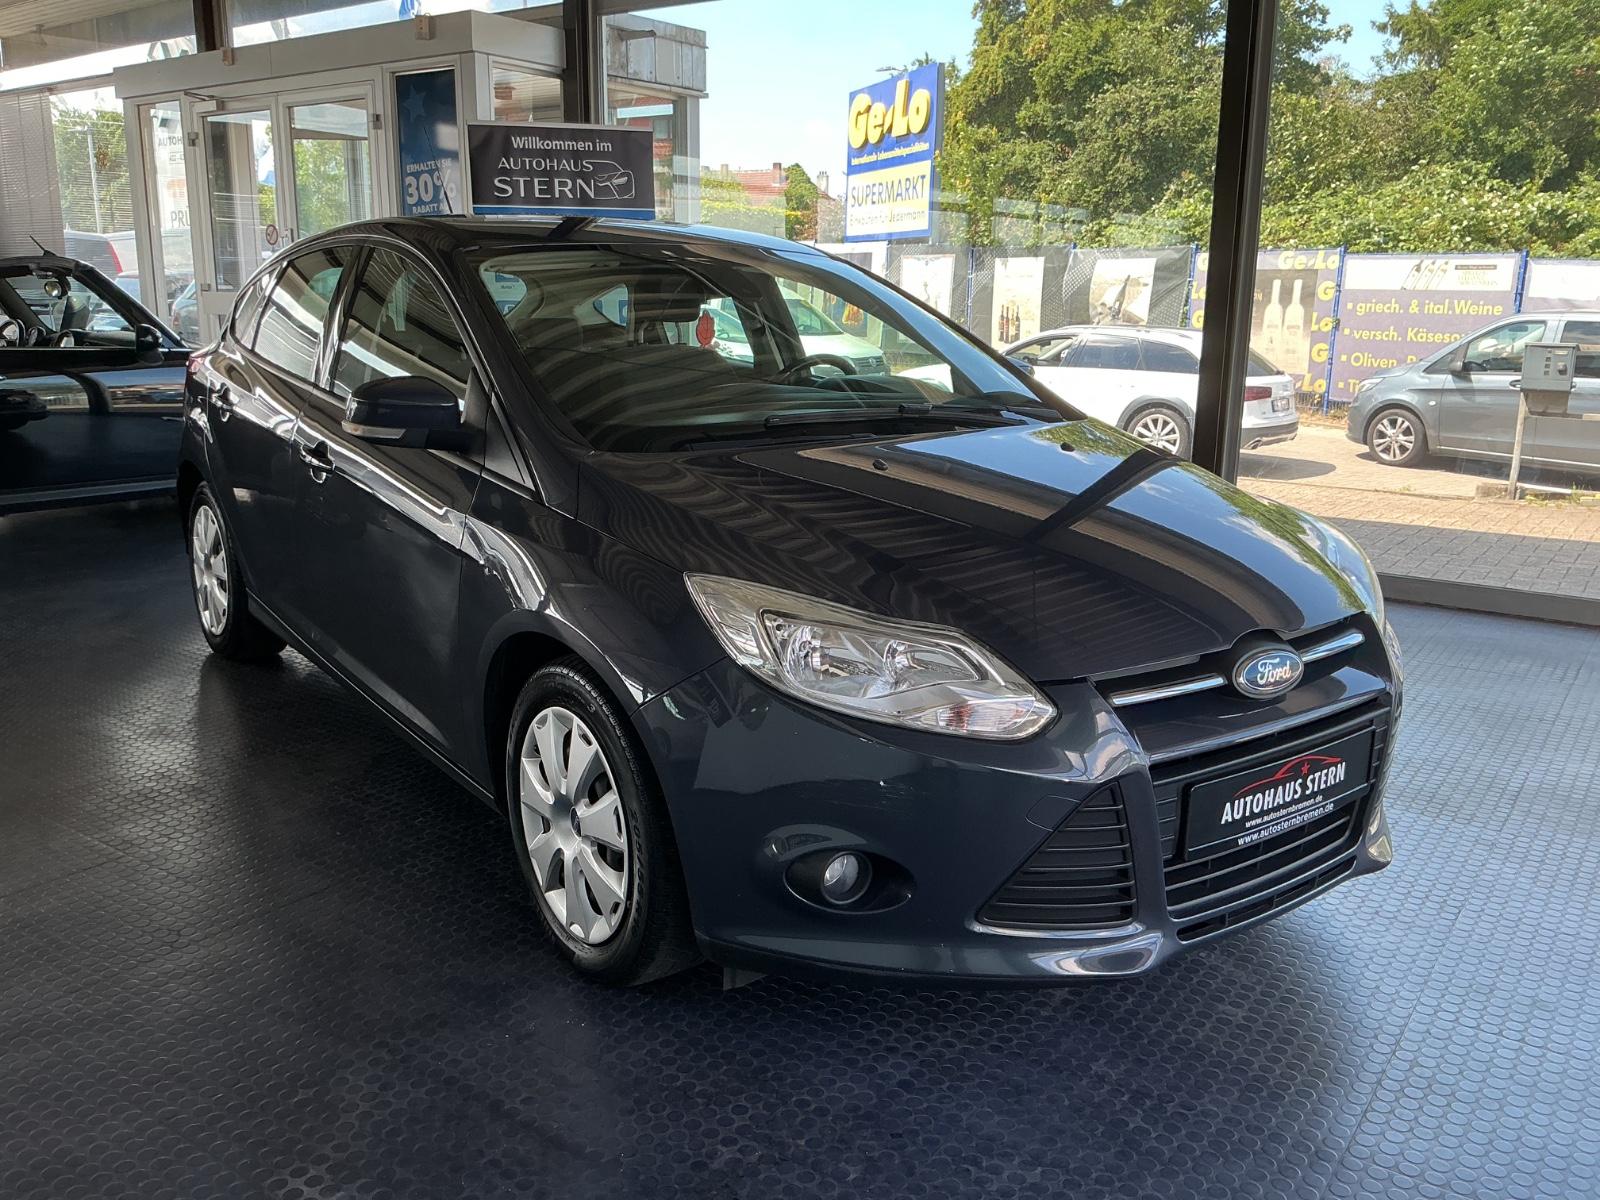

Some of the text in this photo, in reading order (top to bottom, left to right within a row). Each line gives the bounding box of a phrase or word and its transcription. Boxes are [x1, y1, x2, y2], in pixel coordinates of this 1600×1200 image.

[511, 135, 612, 152] Willkommen im
[498, 157, 594, 172] AUTOHAUS
[404, 169, 457, 205] 30%
[493, 176, 595, 199] STERN
[851, 174, 926, 208] SUPERMARKT
[412, 203, 438, 214] RABATT
[1356, 298, 1404, 316] griech.
[1409, 299, 1420, 314] &
[1353, 326, 1460, 343] versch. Käseso
[1257, 657, 1292, 685] Ford
[1220, 761, 1346, 824] AUTOHAUS STERN
[1238, 802, 1334, 845] www.autosternbremen.de
[1245, 795, 1323, 828] www.autosternbremen.de
